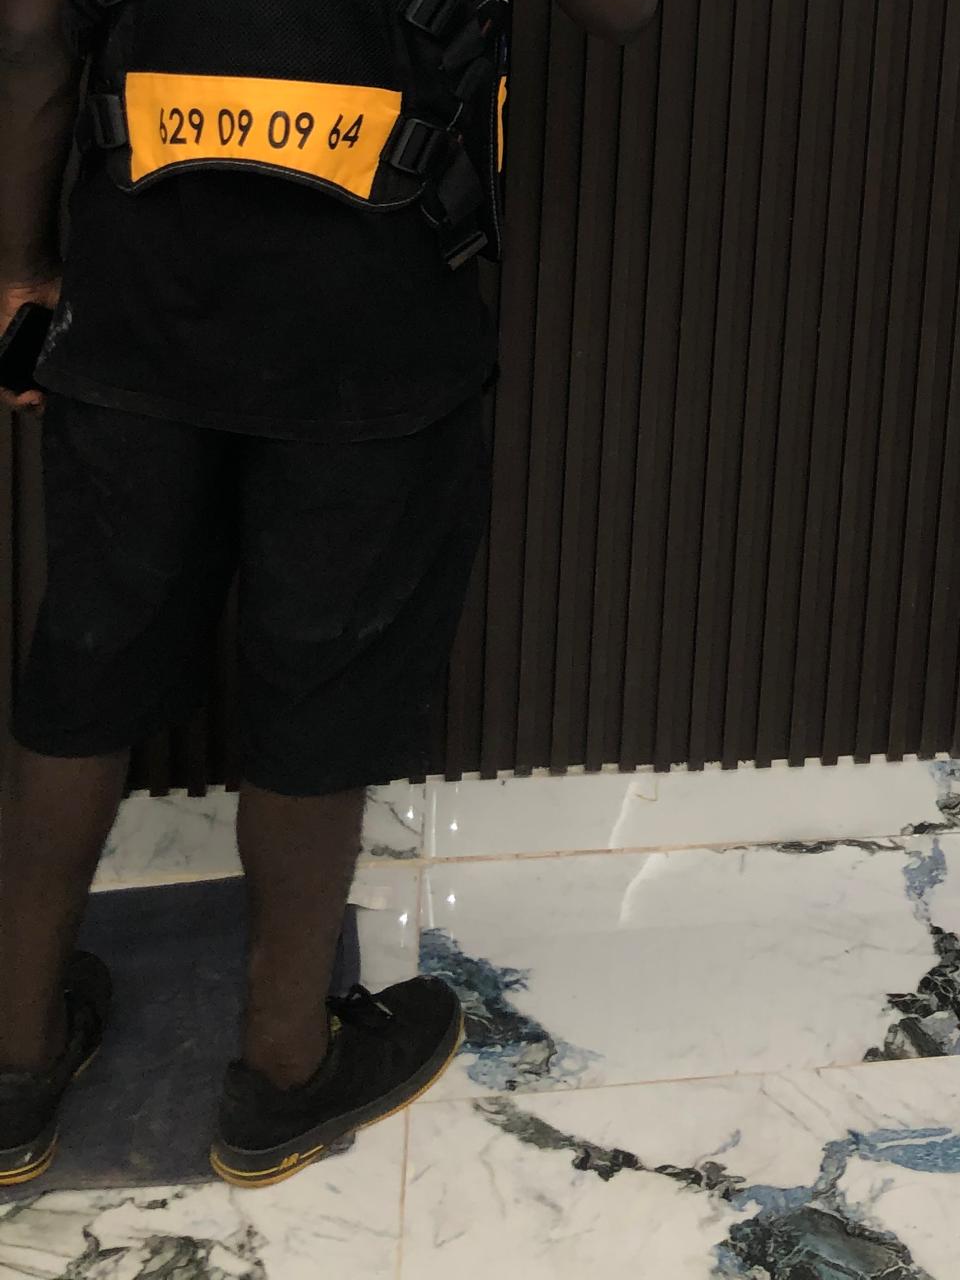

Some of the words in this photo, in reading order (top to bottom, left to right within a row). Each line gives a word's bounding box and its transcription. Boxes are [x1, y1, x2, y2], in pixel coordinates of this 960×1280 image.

[159, 107, 205, 145] 629
[217, 108, 254, 146] 09
[267, 110, 315, 150] 09
[327, 113, 364, 150] 64
